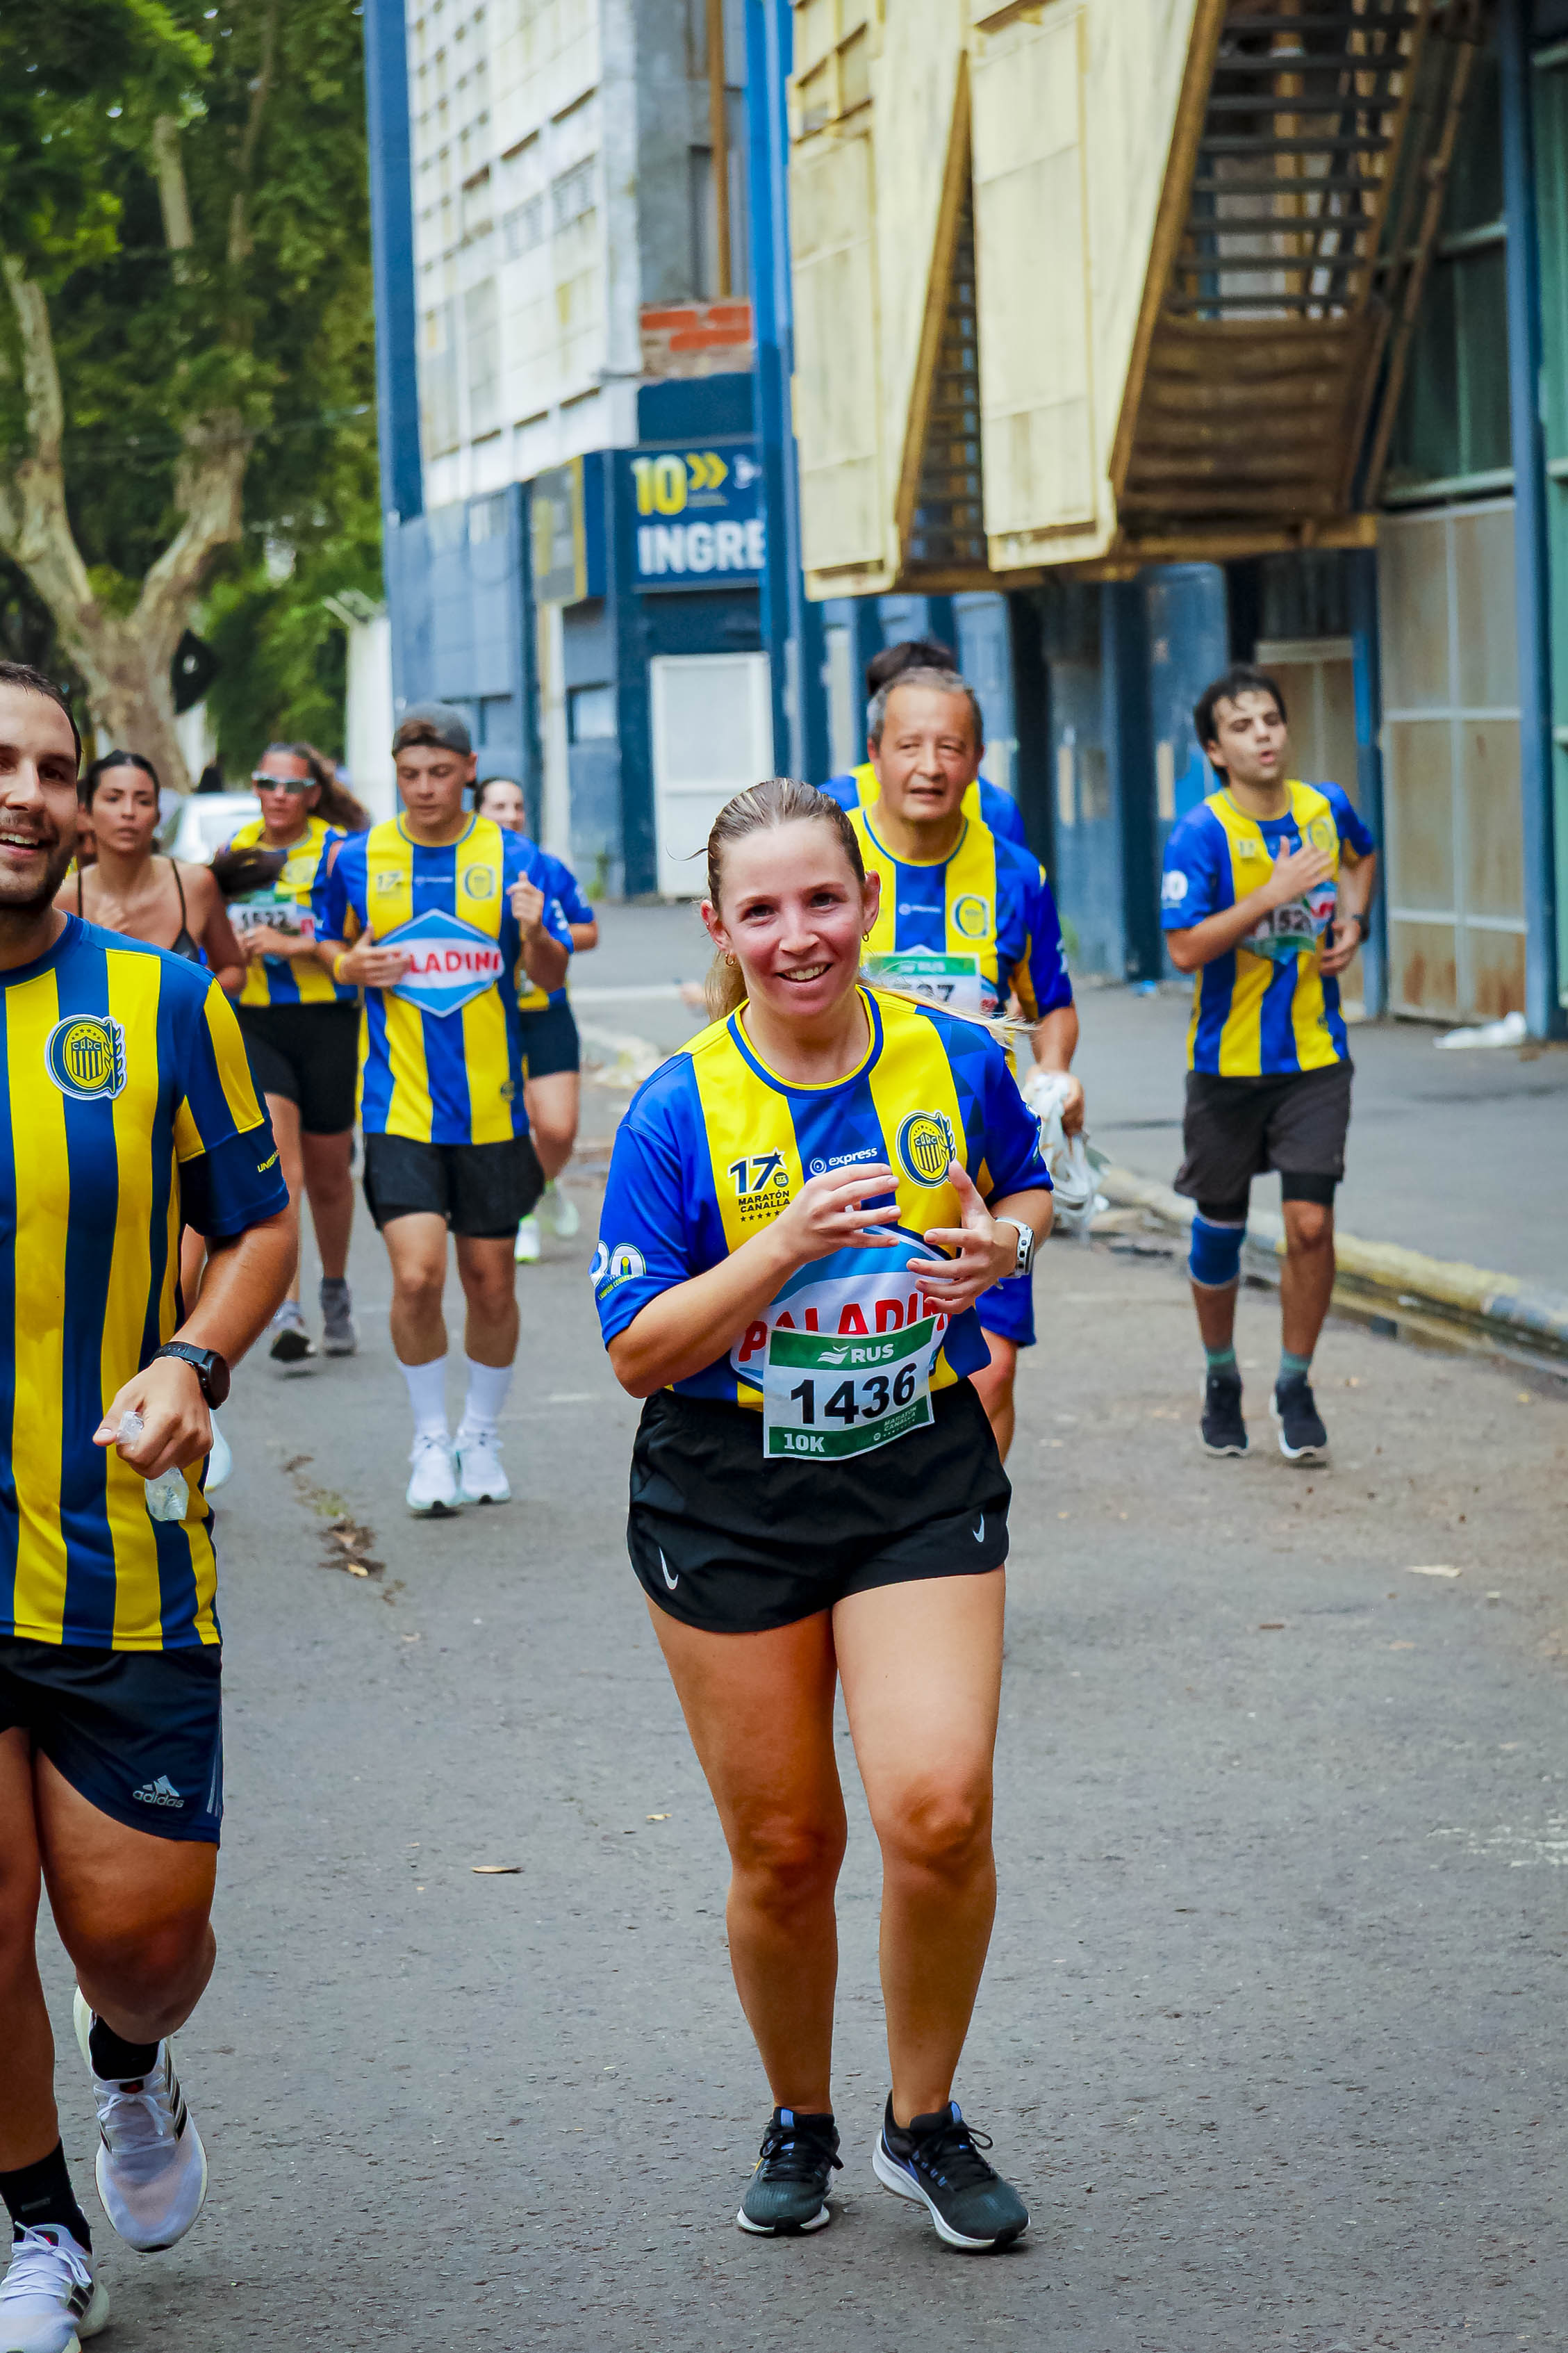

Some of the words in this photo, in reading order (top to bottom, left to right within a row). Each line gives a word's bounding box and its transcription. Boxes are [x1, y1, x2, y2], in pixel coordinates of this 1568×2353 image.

[631, 454, 688, 515] 10
[637, 518, 765, 575] INGRE
[392, 949, 501, 973] LADINI
[72, 1039, 101, 1050] CARC
[915, 1133, 937, 1146] CARC
[828, 1147, 877, 1167] express
[728, 1151, 785, 1195] 17
[738, 1190, 790, 1206] MARATÓN
[740, 1199, 791, 1213] CANALLA
[738, 1291, 952, 1362] PLADIN
[850, 1343, 895, 1364] RUS
[790, 1362, 917, 1425] 1436
[784, 1433, 825, 1453] 10K
[133, 1790, 185, 1808] adidas
